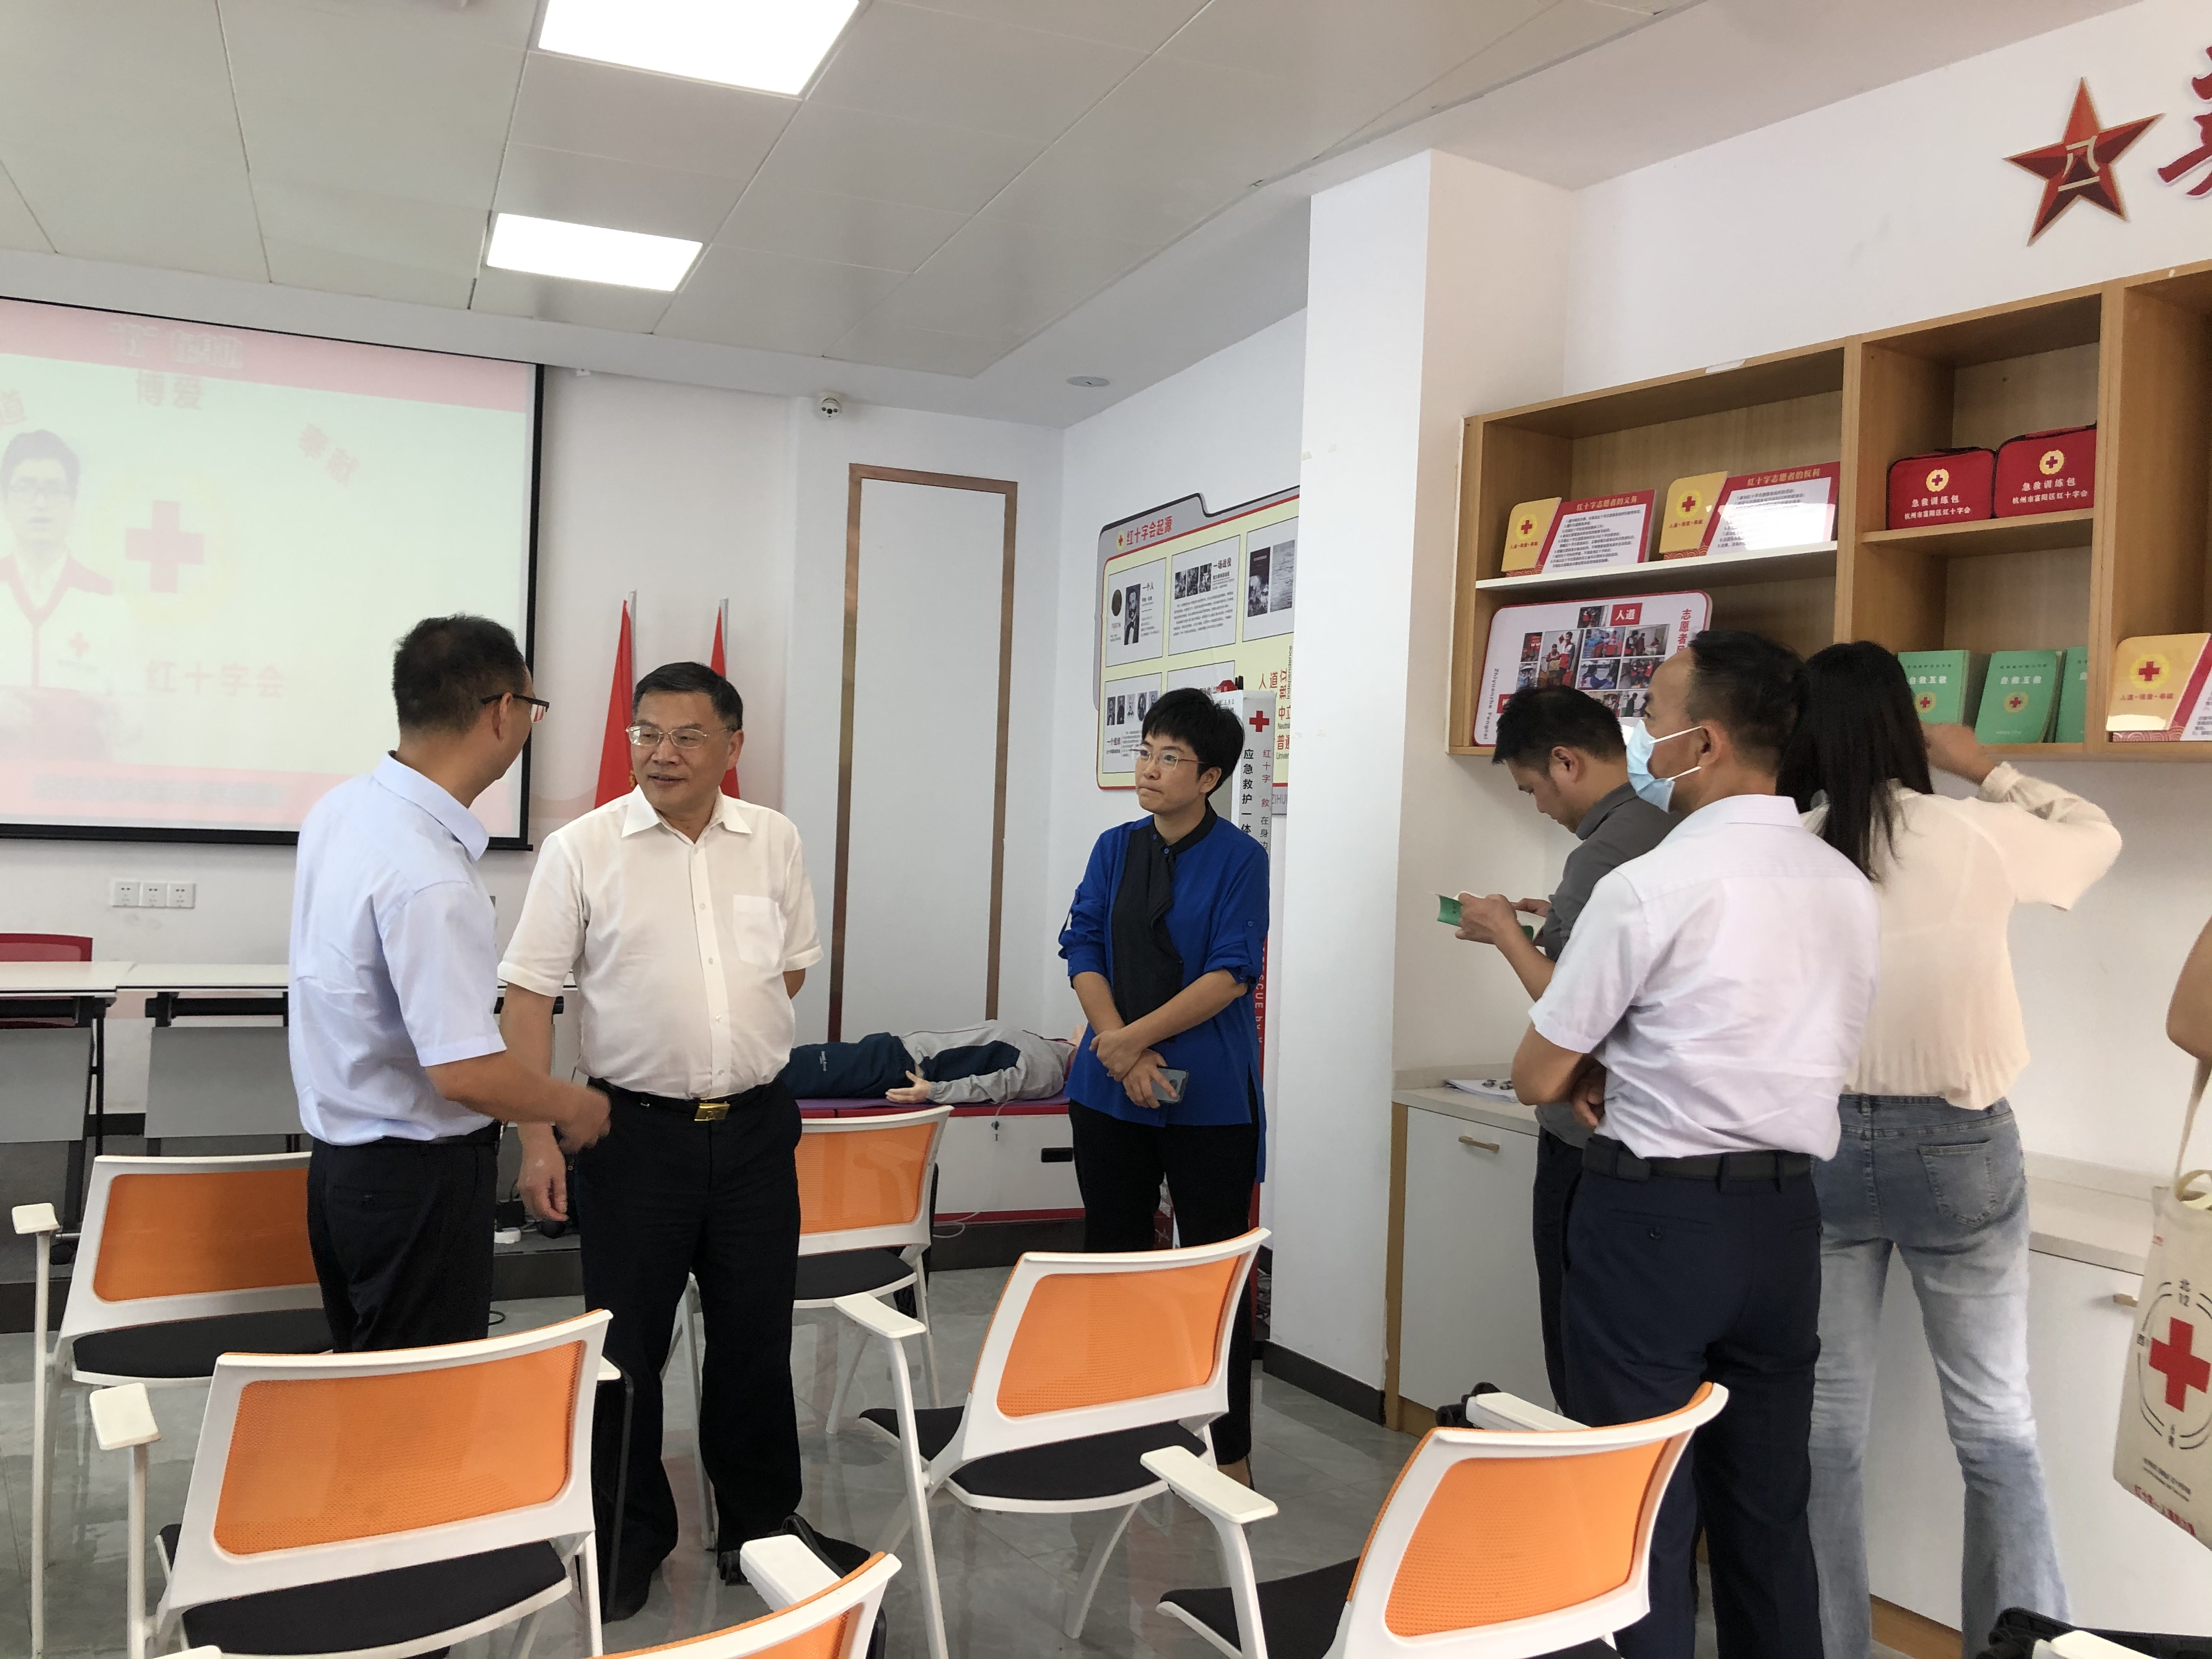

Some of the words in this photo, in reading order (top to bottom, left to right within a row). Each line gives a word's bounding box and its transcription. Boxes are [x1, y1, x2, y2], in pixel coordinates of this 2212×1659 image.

[135, 369, 203, 409] 博爱
[1747, 468, 1820, 486] 红十字志愿者的权利
[2022, 477, 2075, 491] 急救训练包
[1576, 495, 1638, 511] 红十字志愿者的义务
[1911, 495, 1959, 507] 急救训练包
[2012, 489, 2088, 504] 杭州市富阳区红十字会
[1905, 506, 1971, 520] 杭州市富阳区红十字会
[1126, 516, 1172, 545] 红十字会起源
[1615, 608, 1635, 620] 人道
[147, 659, 284, 699] 红十字会
[1259, 671, 1278, 690] 人道
[1909, 675, 1947, 685] 自救互救
[2000, 675, 2042, 685] 自救互救
[1241, 749, 1254, 834] 应急救护一体
